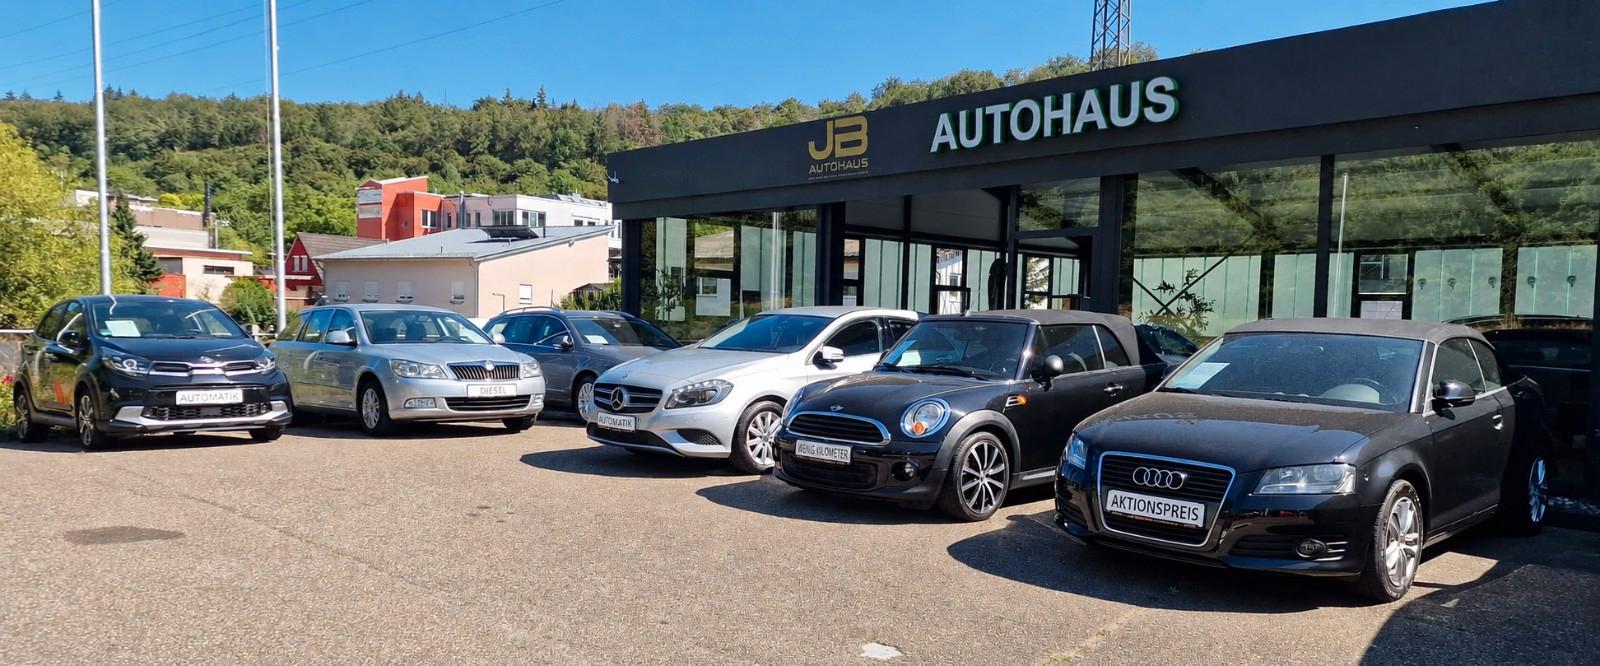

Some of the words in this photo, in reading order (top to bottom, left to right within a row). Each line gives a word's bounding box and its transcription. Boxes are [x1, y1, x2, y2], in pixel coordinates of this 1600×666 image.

[930, 76, 1179, 153] AUTOHAUS
[808, 115, 868, 160] JB
[808, 158, 869, 175] AUTOHAUS
[180, 392, 240, 402] AUTOMATIK
[480, 386, 507, 396] DIESEL
[598, 414, 633, 427] AUTOMATIK
[1111, 494, 1199, 520] AKTIONSPREIS
